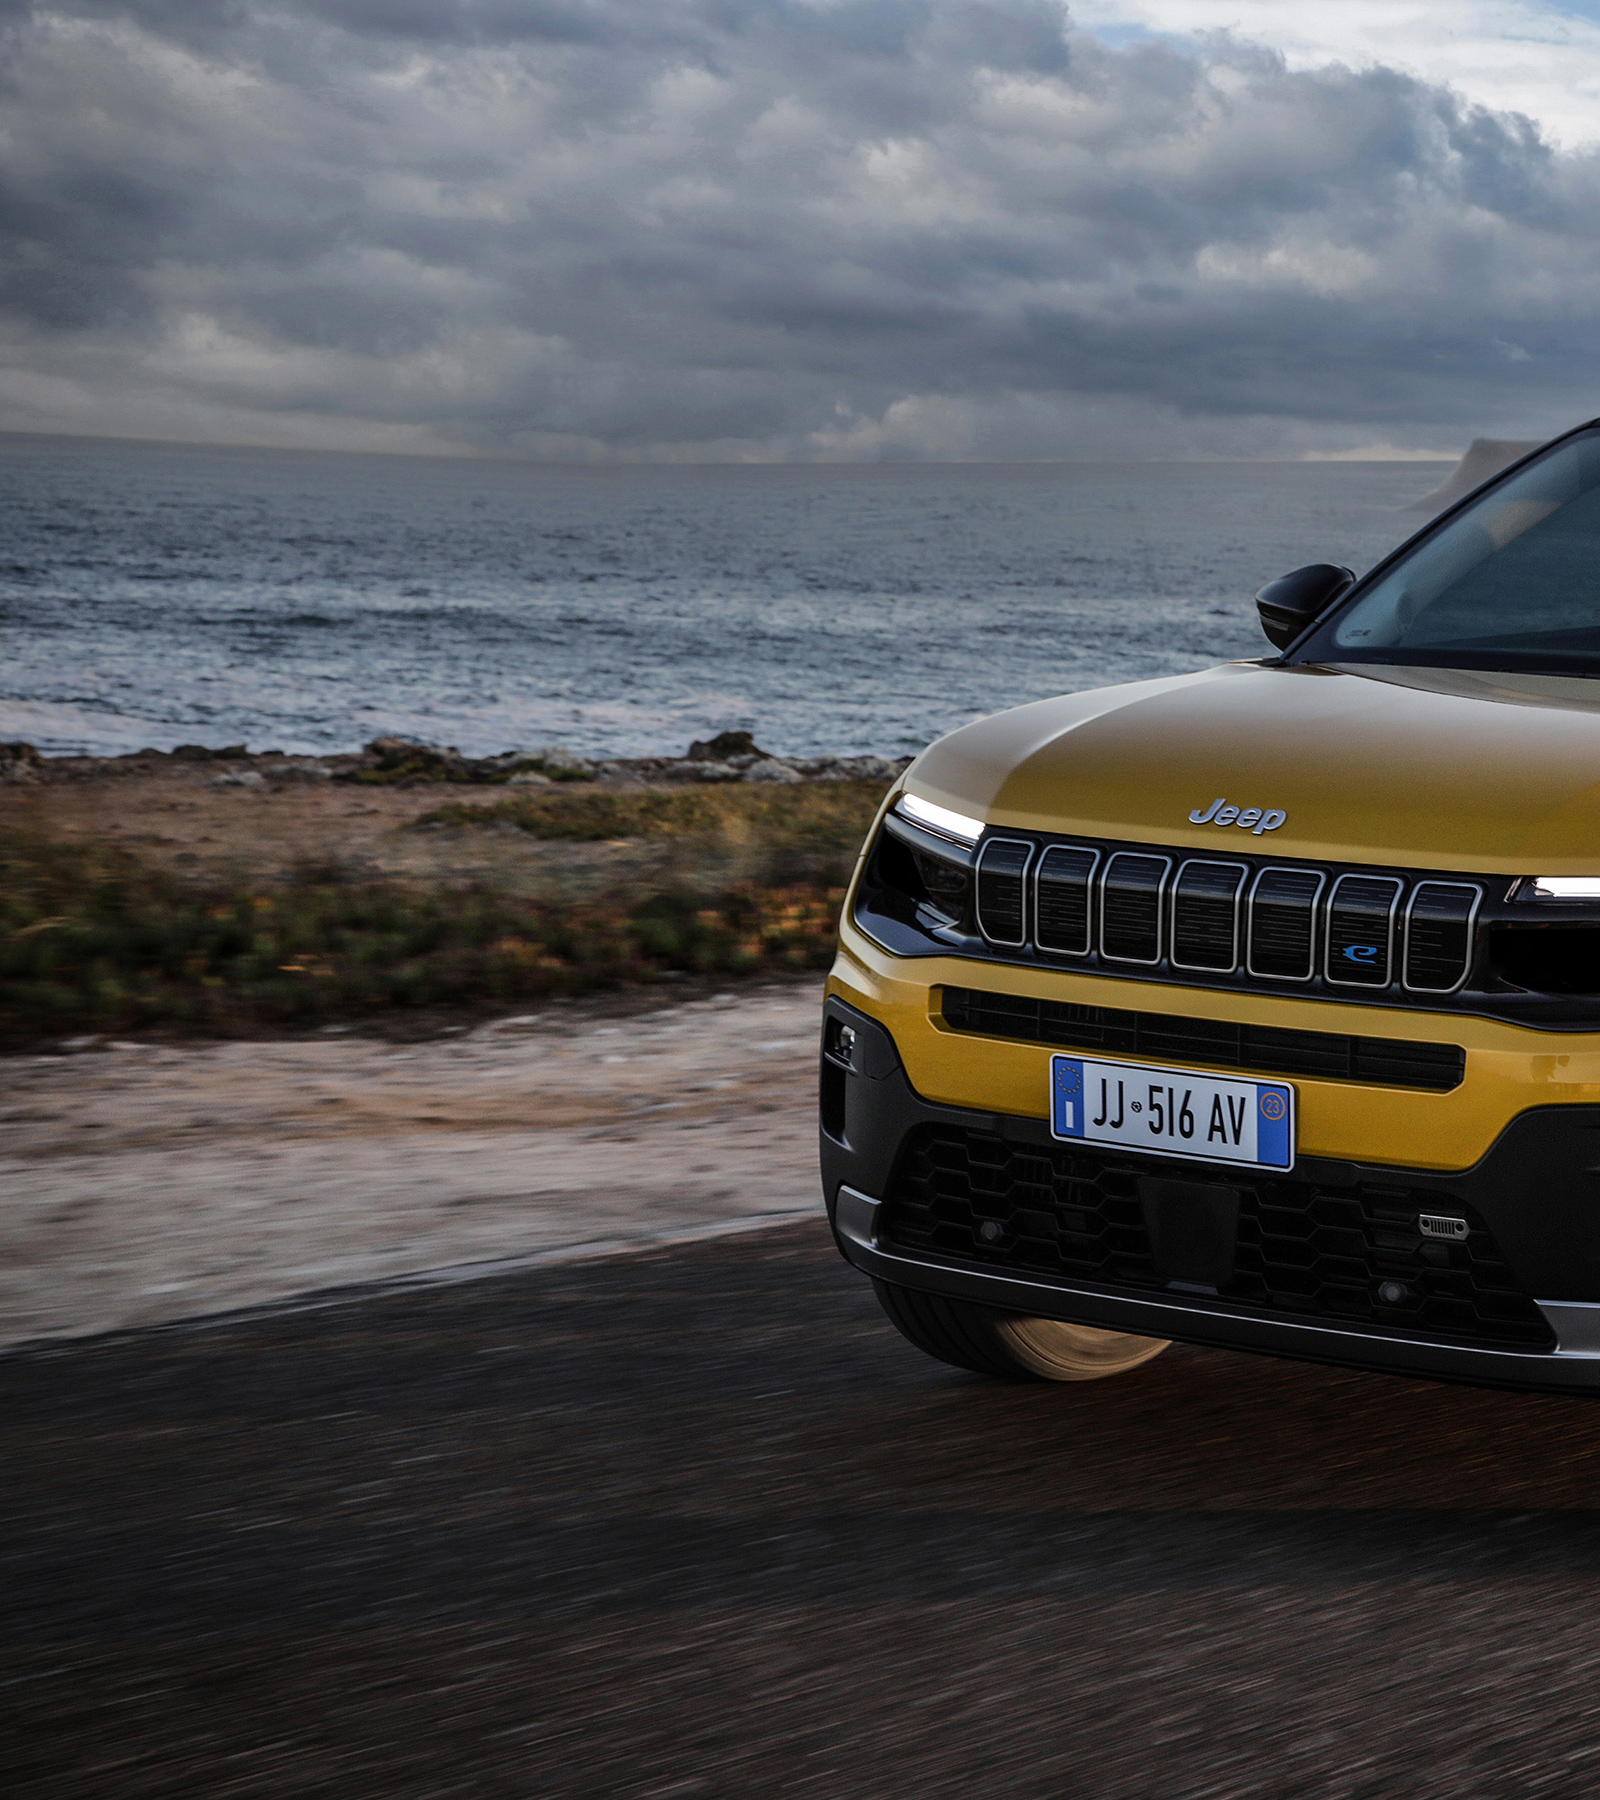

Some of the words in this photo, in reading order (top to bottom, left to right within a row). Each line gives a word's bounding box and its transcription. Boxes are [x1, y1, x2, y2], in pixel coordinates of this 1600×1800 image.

[1188, 798, 1287, 835] Jeep
[1092, 1078, 1124, 1129] JJ
[1148, 1084, 1194, 1139] 516
[1207, 1093, 1246, 1146] AV
[1266, 1099, 1280, 1114] 23
